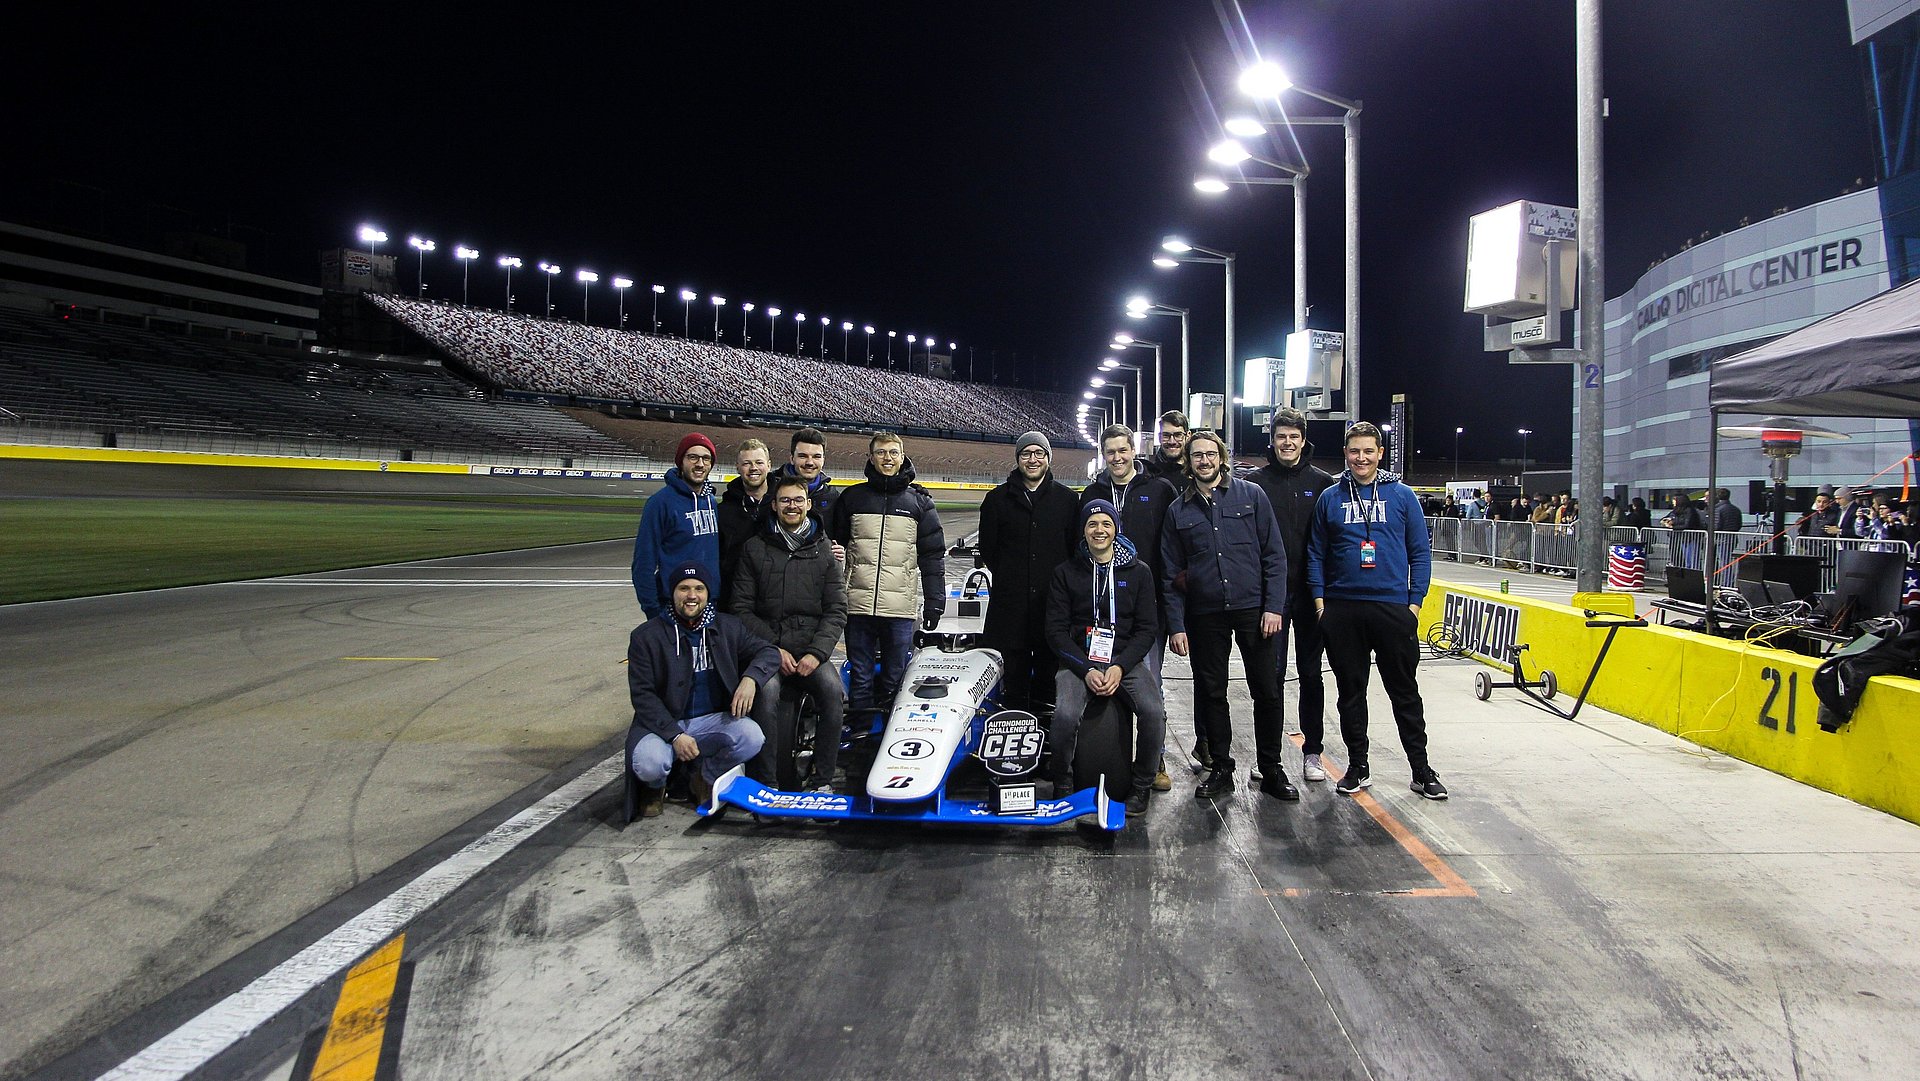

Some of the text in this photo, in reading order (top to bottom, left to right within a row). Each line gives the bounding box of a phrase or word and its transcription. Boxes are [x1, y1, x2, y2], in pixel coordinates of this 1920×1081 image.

[1677, 269, 1743, 313] DIGITAL
[1749, 237, 1863, 290] CENTER
[493, 467, 514, 475] GEICO
[1443, 593, 1520, 664] PENNZOIL
[1758, 666, 1797, 734] 21
[988, 720, 1035, 728] AUTONOMOUS
[988, 726, 1028, 734] CHALLENGE
[901, 742, 922, 757] 3
[984, 733, 1040, 757] CES
[748, 794, 848, 811] WINNERS
[758, 790, 847, 803] INDIANA
[1012, 791, 1031, 799] PLACE
